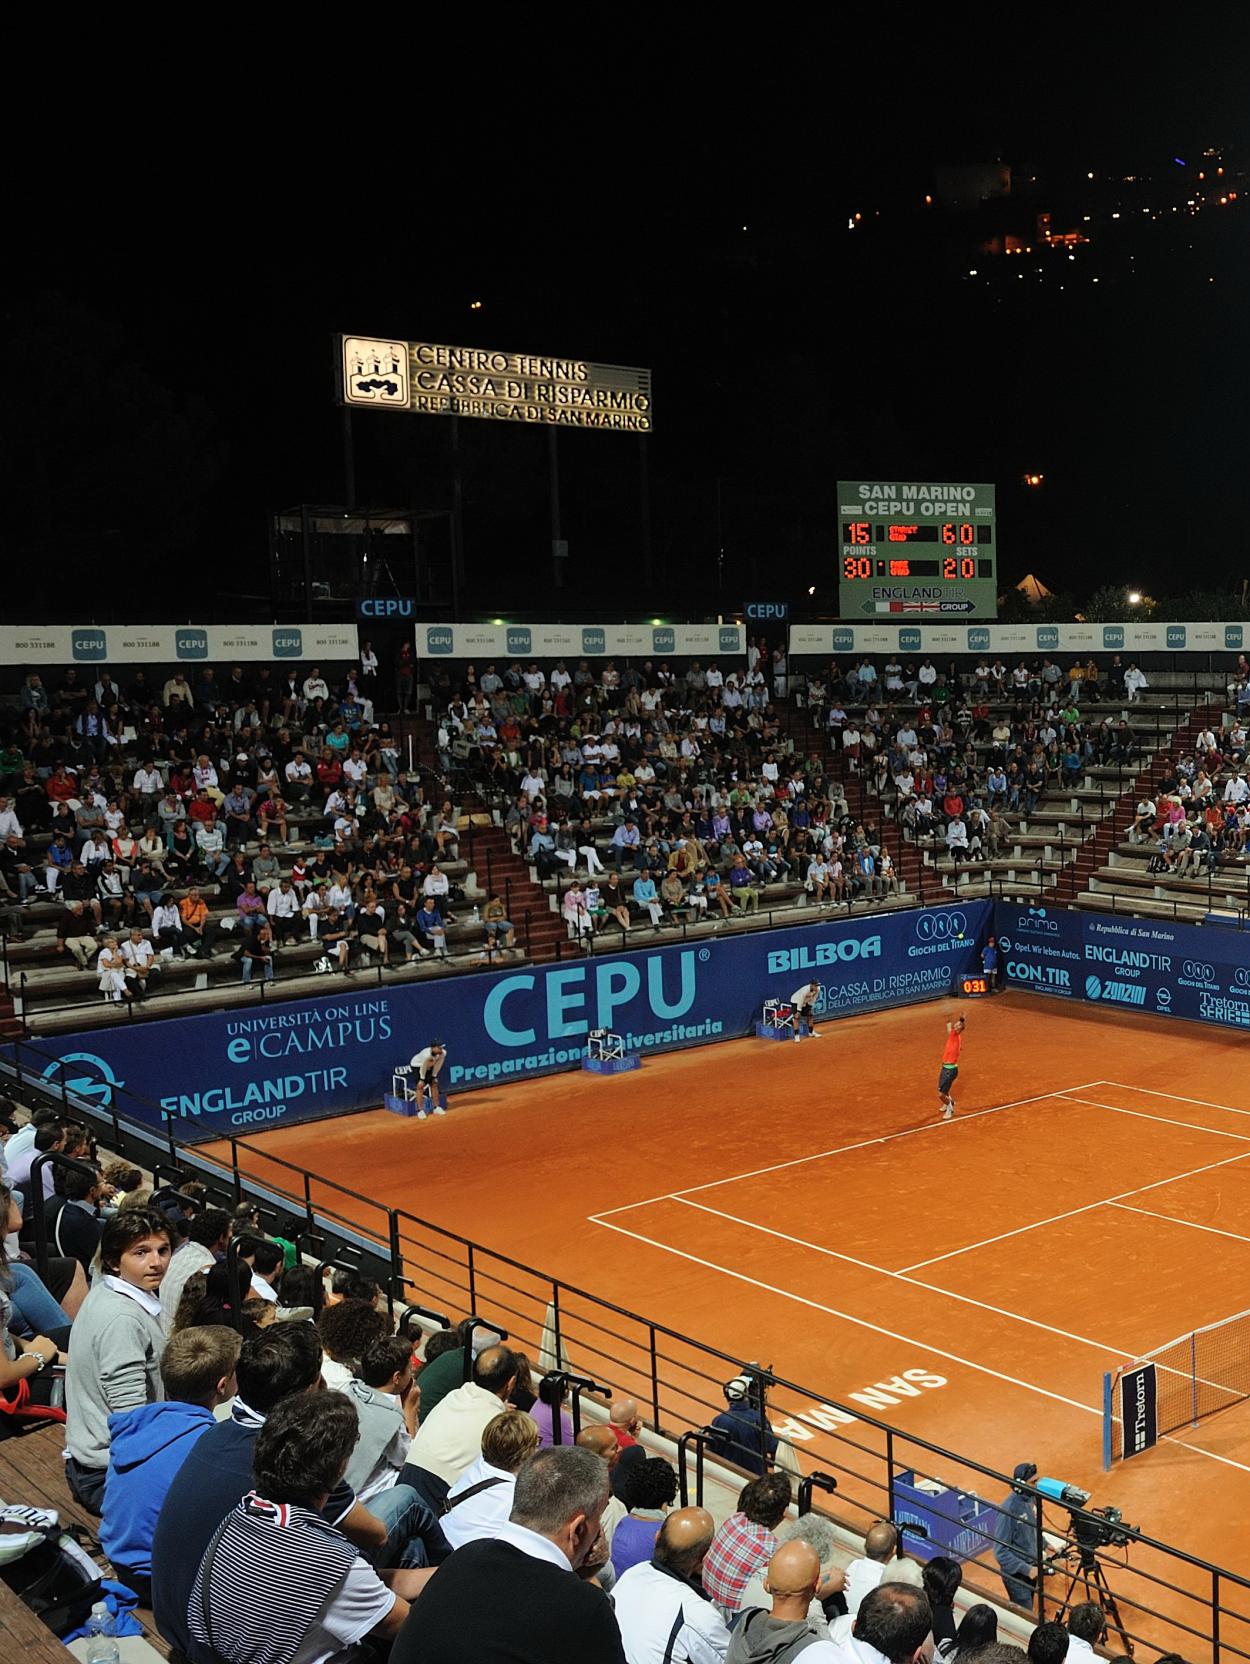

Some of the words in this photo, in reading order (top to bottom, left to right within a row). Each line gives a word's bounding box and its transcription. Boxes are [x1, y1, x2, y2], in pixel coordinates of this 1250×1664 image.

[416, 346, 508, 372] CENTRO
[516, 356, 588, 382] TENNIS
[417, 372, 498, 396] CASSA
[508, 380, 528, 398] DI
[538, 384, 648, 412] RISPARMIO
[417, 395, 521, 420] REPUBBLICA
[526, 406, 543, 420] DI
[548, 408, 581, 424] SAN
[586, 412, 650, 430] MARINO
[859, 485, 896, 499] SAN
[902, 486, 975, 500] MARINO
[864, 502, 914, 514] CEPU
[920, 503, 970, 516] OPEN
[849, 523, 869, 544] 15
[844, 546, 876, 556] POINTS
[956, 547, 978, 556] SETS
[844, 558, 870, 578] 30
[362, 600, 412, 616] CEPU
[748, 604, 785, 618] CEPU
[941, 602, 969, 611] GROUP
[76, 640, 104, 649] CEPU
[179, 640, 206, 648] CEPU
[275, 639, 300, 647] CEPU
[430, 637, 452, 645] CEPU
[509, 637, 529, 645] CEPU
[969, 635, 988, 643] CEPU
[1038, 634, 1056, 642] CEPU
[1019, 917, 1058, 930] prima
[1096, 924, 1128, 934] Repubblica
[1130, 928, 1137, 936] di
[1137, 929, 1150, 938] San
[1151, 931, 1175, 940] Marino
[768, 936, 881, 974] BILBOA
[938, 942, 950, 952] DEL
[1015, 943, 1031, 952] Opel.
[1032, 945, 1042, 953] Wir
[1043, 946, 1060, 957] leben
[1061, 950, 1080, 960] Autos.
[1007, 962, 1070, 986] CON.TIR
[1114, 967, 1140, 978] GROUP
[828, 981, 869, 1000] CASSA
[874, 979, 886, 992] DI
[890, 966, 950, 988] RISPARMIO
[964, 980, 987, 993] 031
[829, 998, 851, 1009] DELLA
[853, 990, 895, 1004] REPUBBLICA
[897, 988, 904, 996] DI
[905, 985, 920, 995] SAN
[922, 979, 950, 991] MARINO
[1200, 992, 1250, 1012] Tretorn
[227, 1009, 321, 1035] UNIVERSITÀ
[326, 1006, 349, 1020] ON
[355, 1000, 388, 1016] LINE
[1200, 1004, 1235, 1021] SERIE
[232, 1105, 286, 1125] GROUP
[848, 1369, 948, 1410] SAN
[1135, 1372, 1145, 1433] Tretorn
